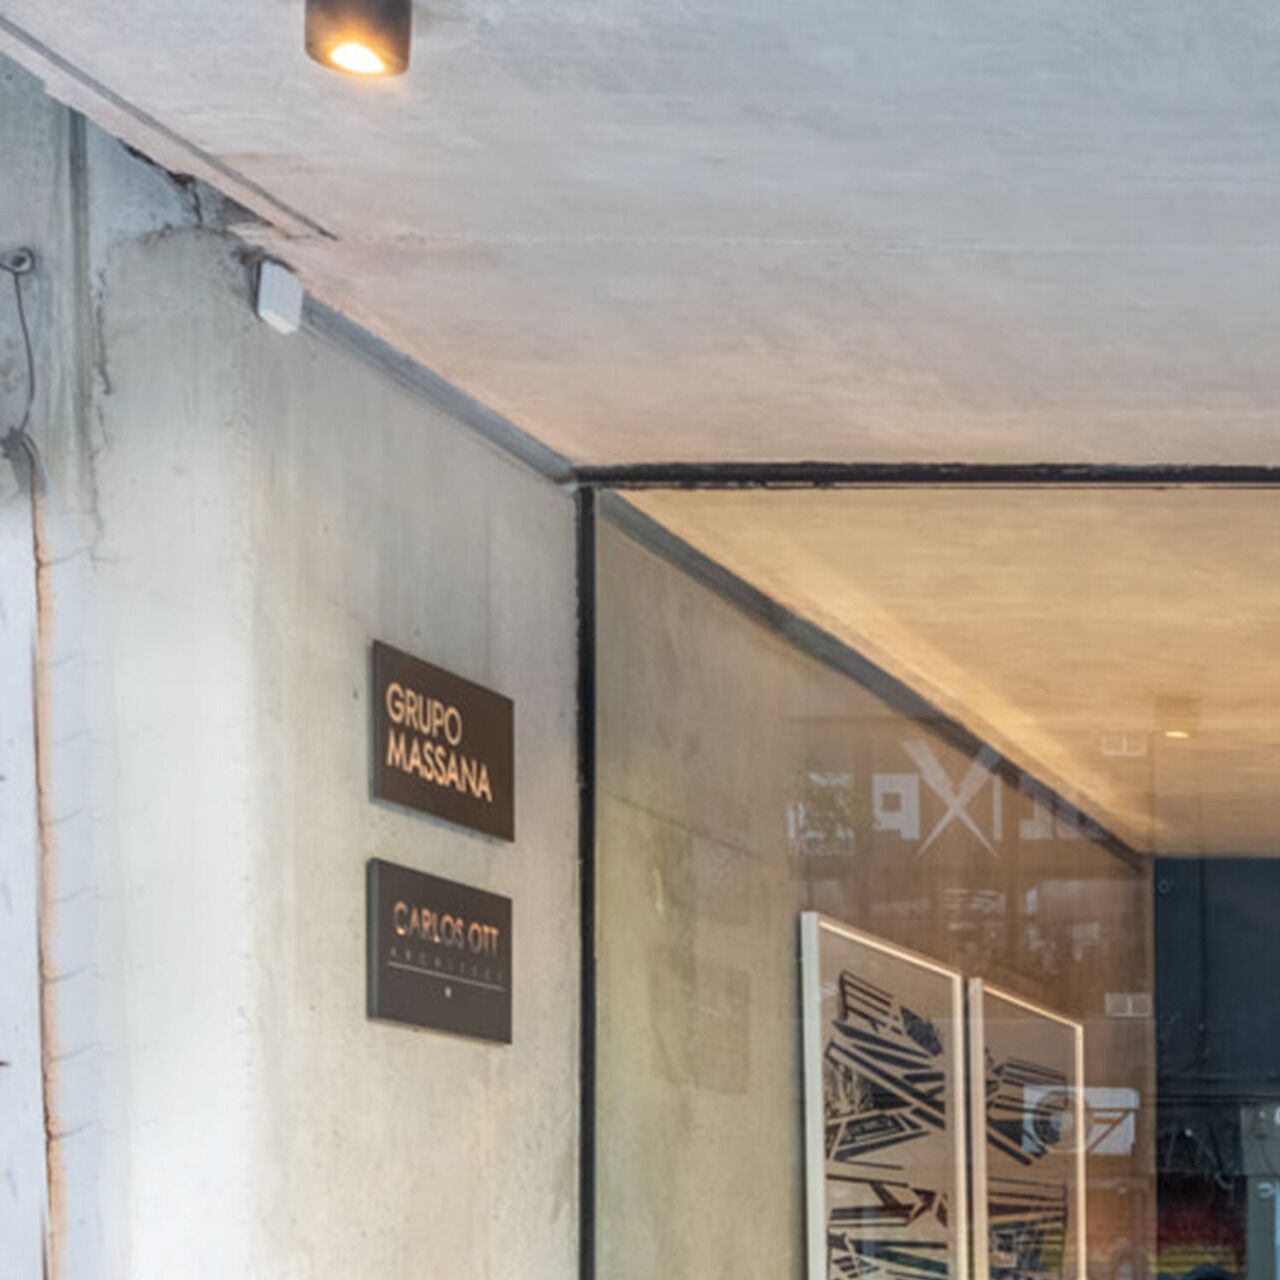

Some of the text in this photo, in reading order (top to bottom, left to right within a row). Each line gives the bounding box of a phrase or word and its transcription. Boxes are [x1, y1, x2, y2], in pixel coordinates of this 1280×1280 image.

[385, 682, 463, 747] GRUPO
[386, 730, 493, 803] MASSANA
[393, 901, 500, 957] CARLOS OTT
